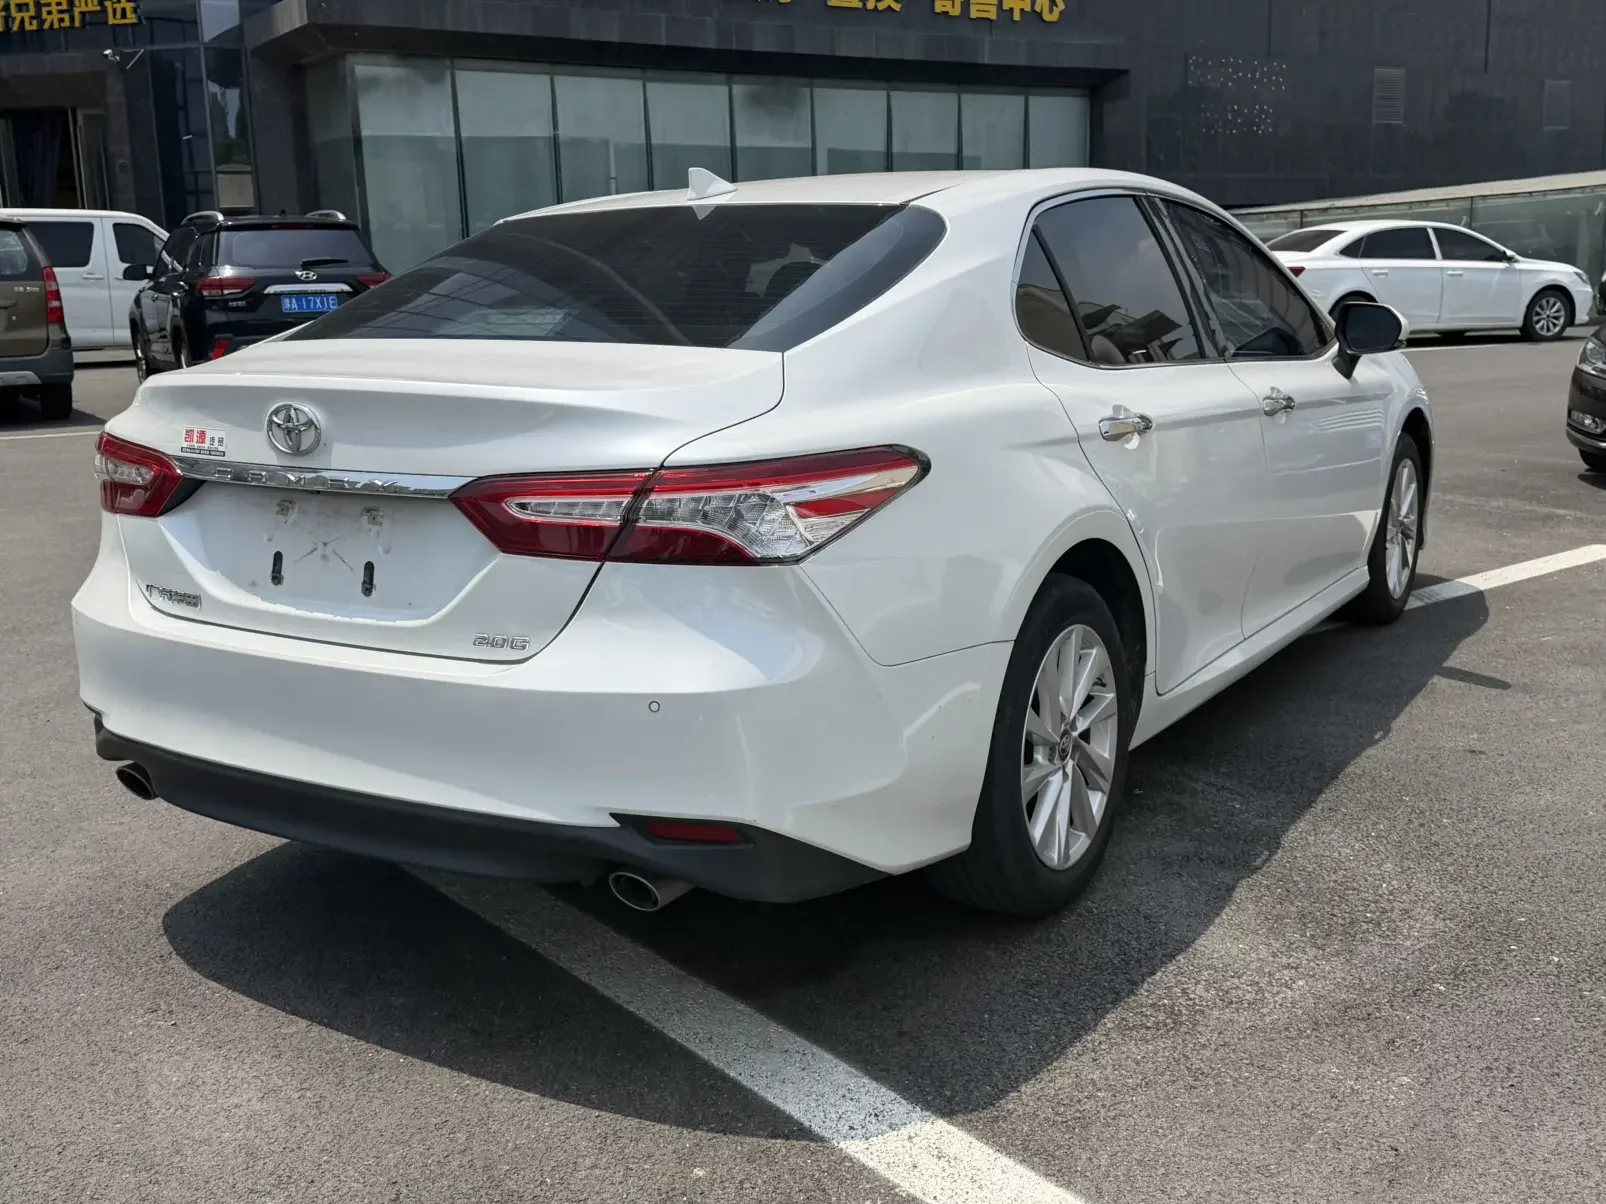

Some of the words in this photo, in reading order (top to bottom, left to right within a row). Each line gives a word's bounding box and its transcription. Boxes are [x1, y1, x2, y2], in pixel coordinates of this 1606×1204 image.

[0, 0, 139, 32] 兄弟严选
[215, 466, 399, 493] CAMRY
